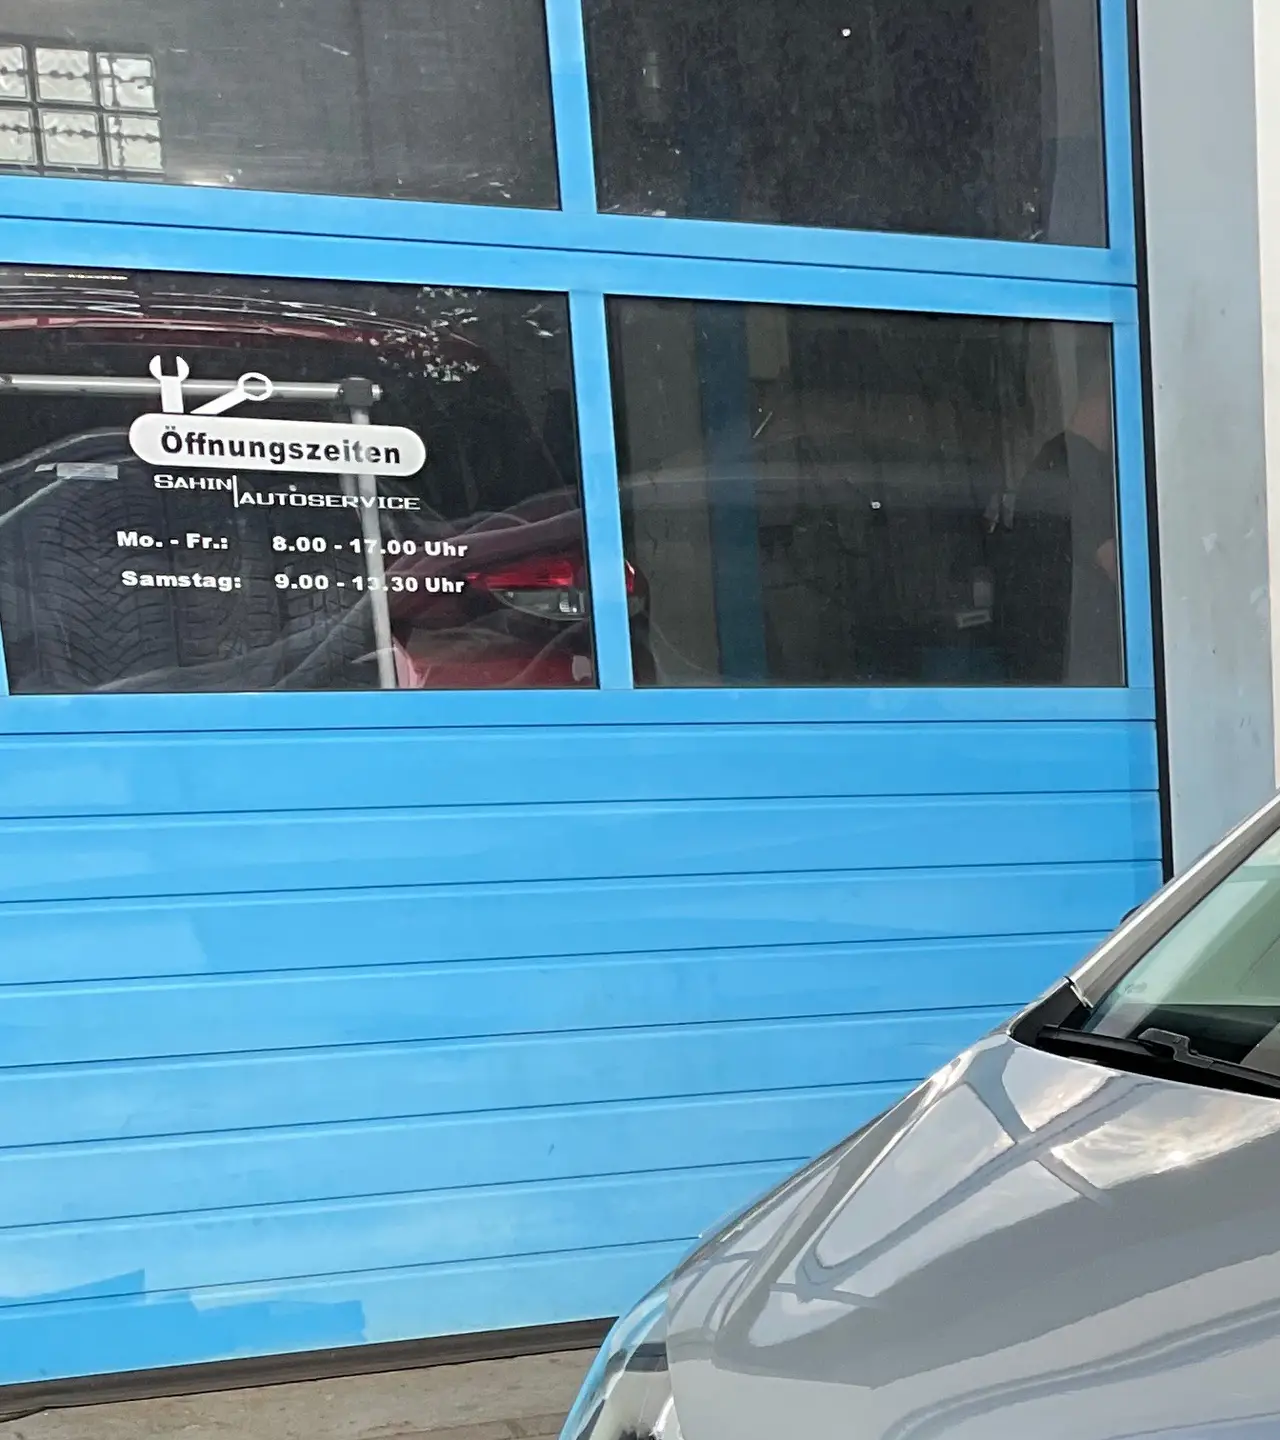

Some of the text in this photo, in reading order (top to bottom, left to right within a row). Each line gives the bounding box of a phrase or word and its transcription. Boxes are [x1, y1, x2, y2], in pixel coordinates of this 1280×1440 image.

[161, 425, 400, 464] Öffnungszeiten
[153, 474, 231, 491] SAHIN
[239, 491, 421, 510] AUTOSERVICE
[116, 530, 163, 548] Mo.
[186, 532, 229, 550] Fr.:
[272, 535, 327, 552] 8.00
[350, 538, 416, 556] 17.00
[424, 540, 468, 557] Uhr
[121, 570, 242, 592] Samstag:
[274, 573, 329, 590] 9.00
[352, 576, 418, 593] 13.30
[425, 577, 465, 593] Uhr
